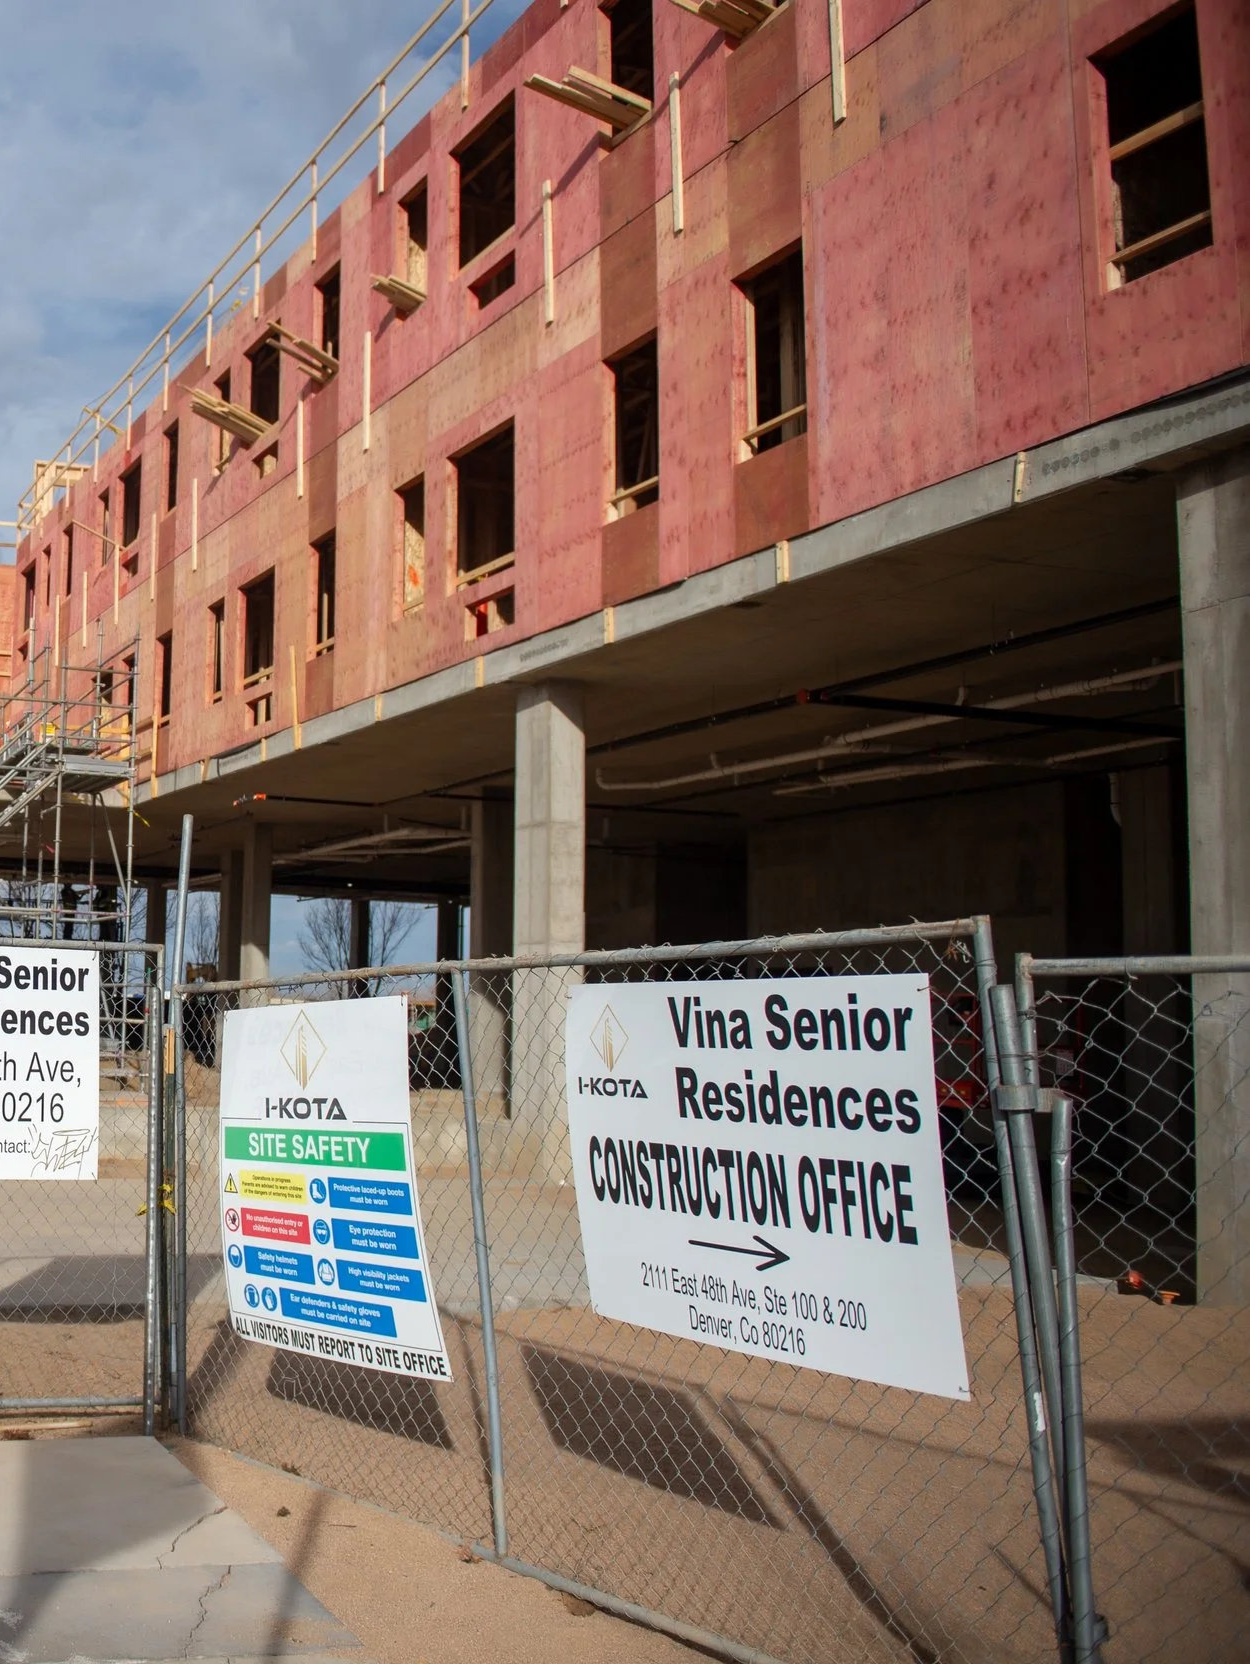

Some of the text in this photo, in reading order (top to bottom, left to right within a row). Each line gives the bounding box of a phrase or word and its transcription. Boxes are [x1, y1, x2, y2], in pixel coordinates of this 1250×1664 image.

[667, 993, 912, 1051] Vina Senior
[26, 1052, 81, 1087] Ave,
[578, 1076, 648, 1099] I-KOTA
[265, 1097, 347, 1120] I-KOTA
[675, 1067, 921, 1134] Residences
[248, 1132, 370, 1163] SITE SAFETY
[333, 1184, 404, 1196] Protective laced-up boots
[588, 1135, 919, 1245] CONSTRUCTION OFFICE
[350, 1196, 388, 1206] must be worn
[252, 1224, 271, 1232] children
[278, 1226, 288, 1235] this
[288, 1228, 298, 1236] site
[254, 1215, 284, 1224] unauthorised
[284, 1218, 296, 1228] entry
[348, 1224, 396, 1238] Eye protection
[352, 1238, 397, 1250] must be worn
[258, 1252, 298, 1265] Safety helmets
[260, 1264, 298, 1276] must be worn
[348, 1266, 410, 1282] High visibility jackets
[360, 1280, 400, 1292] must be worn
[641, 1262, 867, 1331] 2111 East 48th Ave, Ste 100 & 200
[290, 1294, 380, 1318] Ear defenders & safety gloves
[300, 1308, 372, 1328] must be carried on site
[689, 1305, 806, 1356] Denver, Co 80216
[236, 1317, 447, 1376] ALL VISITORS MUST REPORT TO SITE OFFICE
